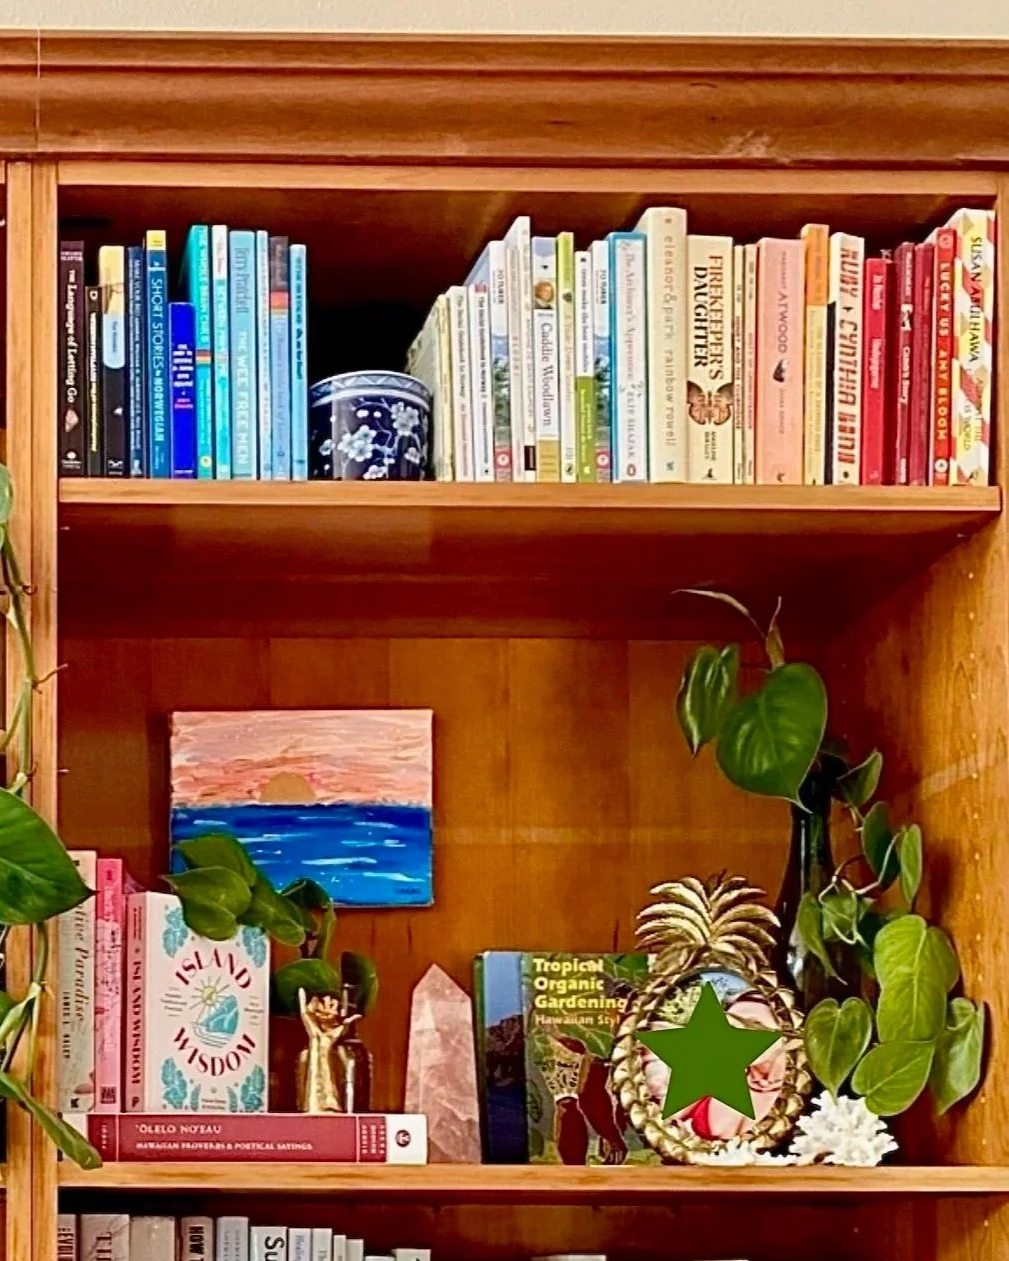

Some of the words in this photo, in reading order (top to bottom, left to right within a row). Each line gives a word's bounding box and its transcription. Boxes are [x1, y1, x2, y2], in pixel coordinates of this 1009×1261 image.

[970, 236, 983, 282] SUSAN
[151, 278, 164, 318] SHORT
[939, 263, 950, 311] LUCKY
[66, 284, 78, 334] Language
[695, 266, 708, 368] DAUGHTER
[710, 254, 725, 380] FIREKEEPER'S
[939, 318, 949, 336] US
[969, 286, 983, 362] ABULHAWA
[68, 335, 77, 346] of
[151, 322, 164, 369] STORIES
[541, 323, 553, 362] Caddie
[66, 348, 78, 386] Letting
[237, 355, 248, 384] WEE
[938, 350, 950, 380] AMY
[67, 388, 78, 402] Go
[153, 377, 164, 442] NORWEGIAN
[237, 391, 248, 430] FREE
[541, 366, 553, 426] Woodlawn
[938, 388, 950, 440] BLOOM
[237, 432, 248, 465] MEN
[74, 947, 89, 1022] Paradise
[175, 948, 252, 990] ISLAND
[532, 958, 604, 977] Tropical
[534, 976, 604, 994] Organic
[131, 961, 143, 1016] ISLAND
[534, 994, 629, 1014] Gardening
[535, 1014, 593, 1026] Hawaiian
[597, 1014, 621, 1027] Styl
[131, 1018, 143, 1085] WISDOM
[174, 1028, 255, 1077] WISDOM
[189, 1226, 204, 1254] HOW
